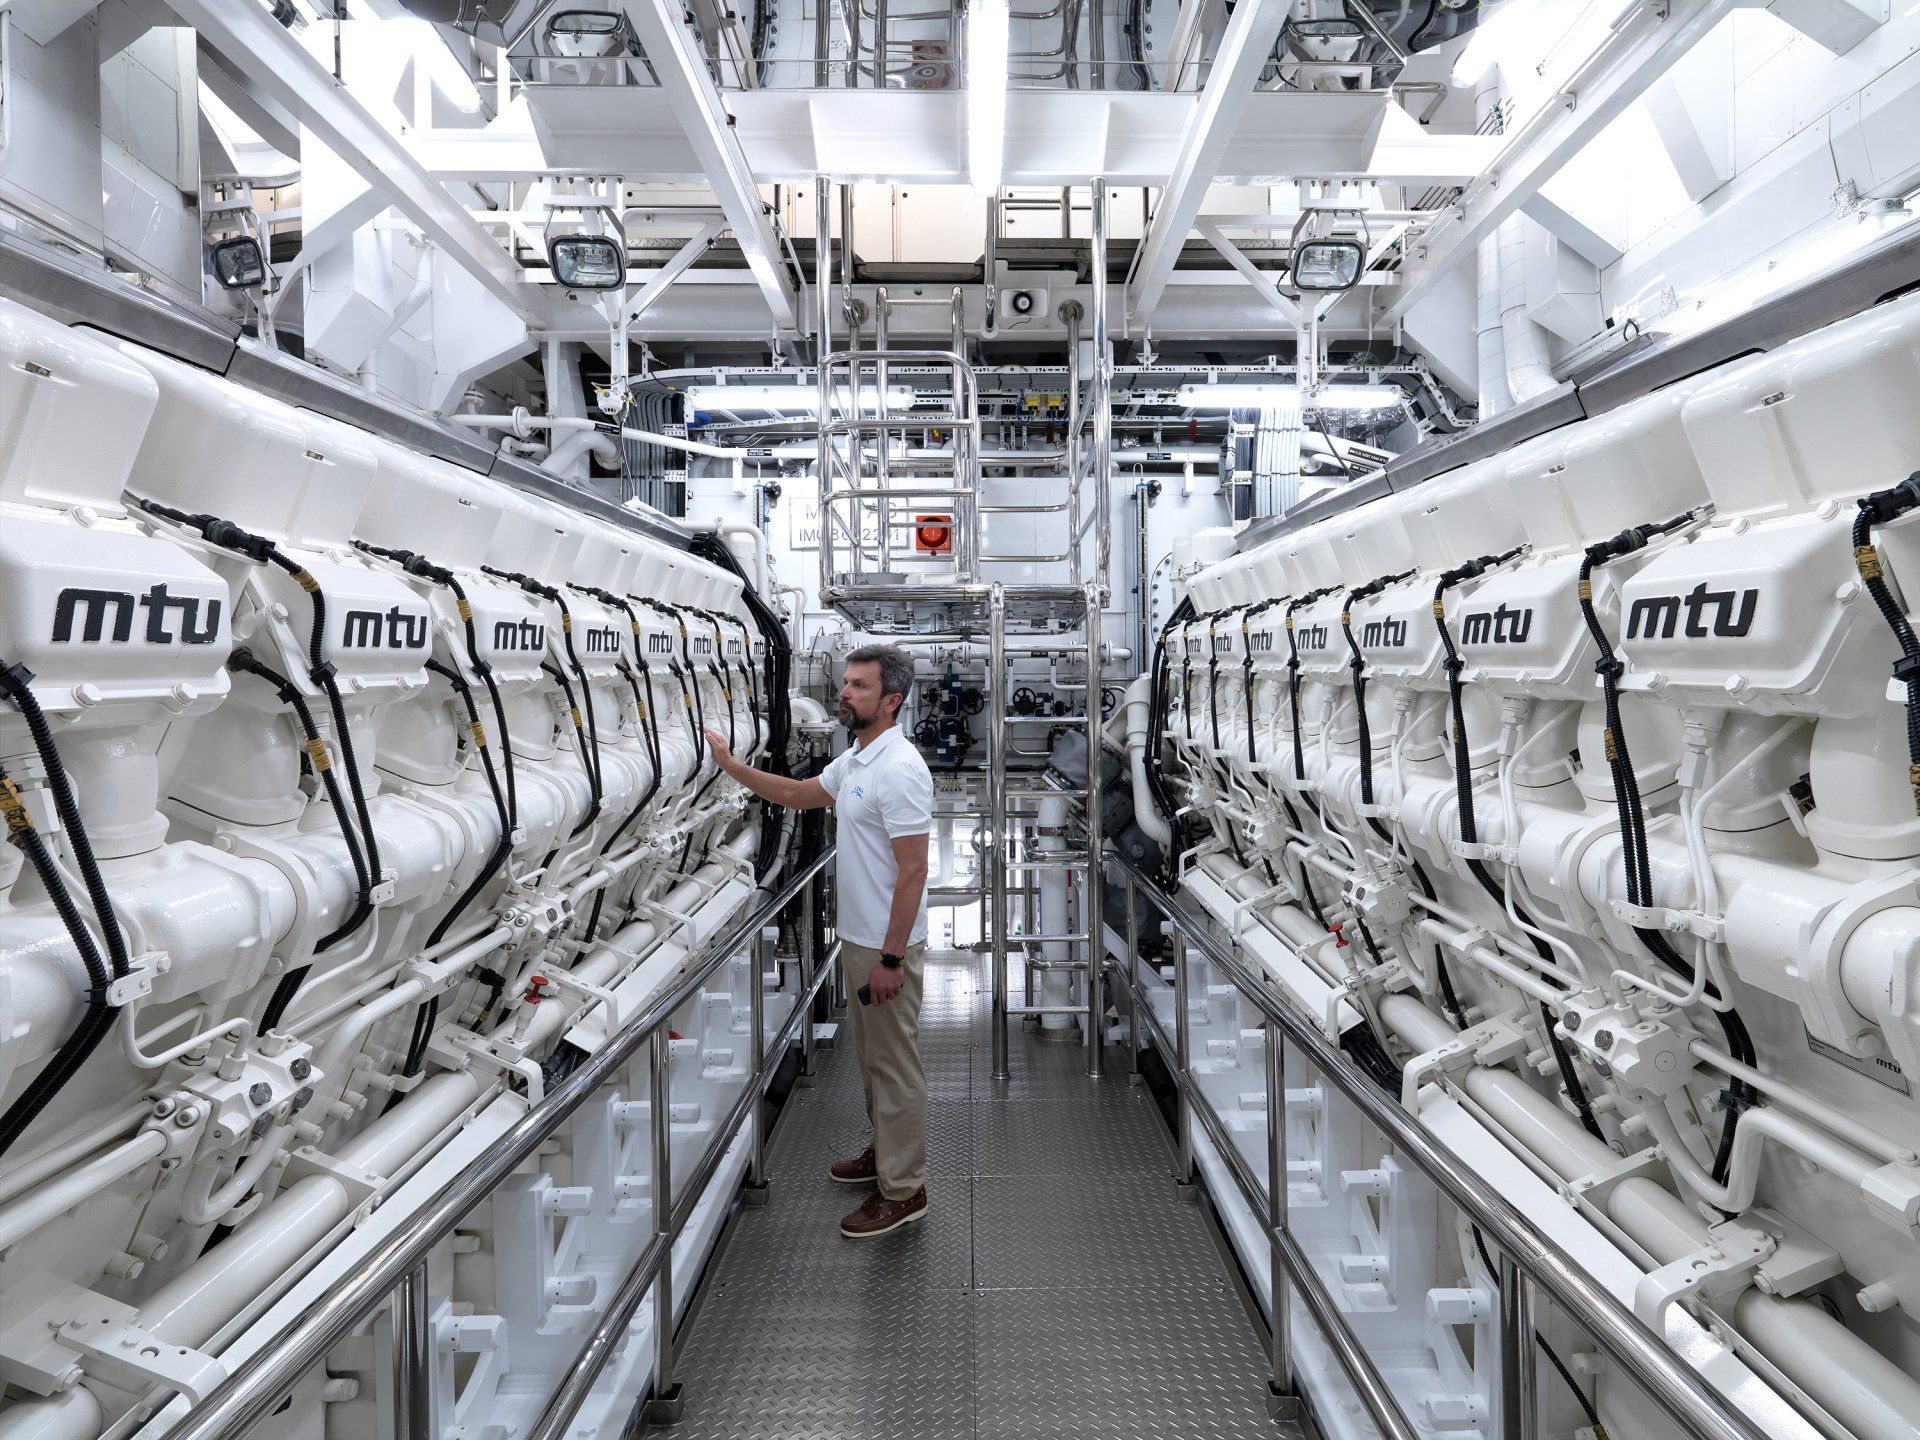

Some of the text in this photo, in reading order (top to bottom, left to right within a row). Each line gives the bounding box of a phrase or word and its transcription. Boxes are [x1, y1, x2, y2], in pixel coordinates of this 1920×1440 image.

[52, 583, 221, 645] mtu
[1462, 602, 1533, 645] mtu
[1626, 582, 1759, 640] mtu
[343, 605, 428, 649] mtu
[494, 618, 544, 651] mtu
[586, 624, 620, 652] mtu
[1250, 628, 1273, 651] mtu
[1297, 623, 1328, 650] mtu
[1362, 615, 1407, 648] mtu
[649, 630, 672, 654] mtu
[693, 633, 711, 654] mtu
[727, 637, 742, 655] mtu
[1215, 632, 1232, 652] mtu
[1876, 1057, 1902, 1075] mtu
